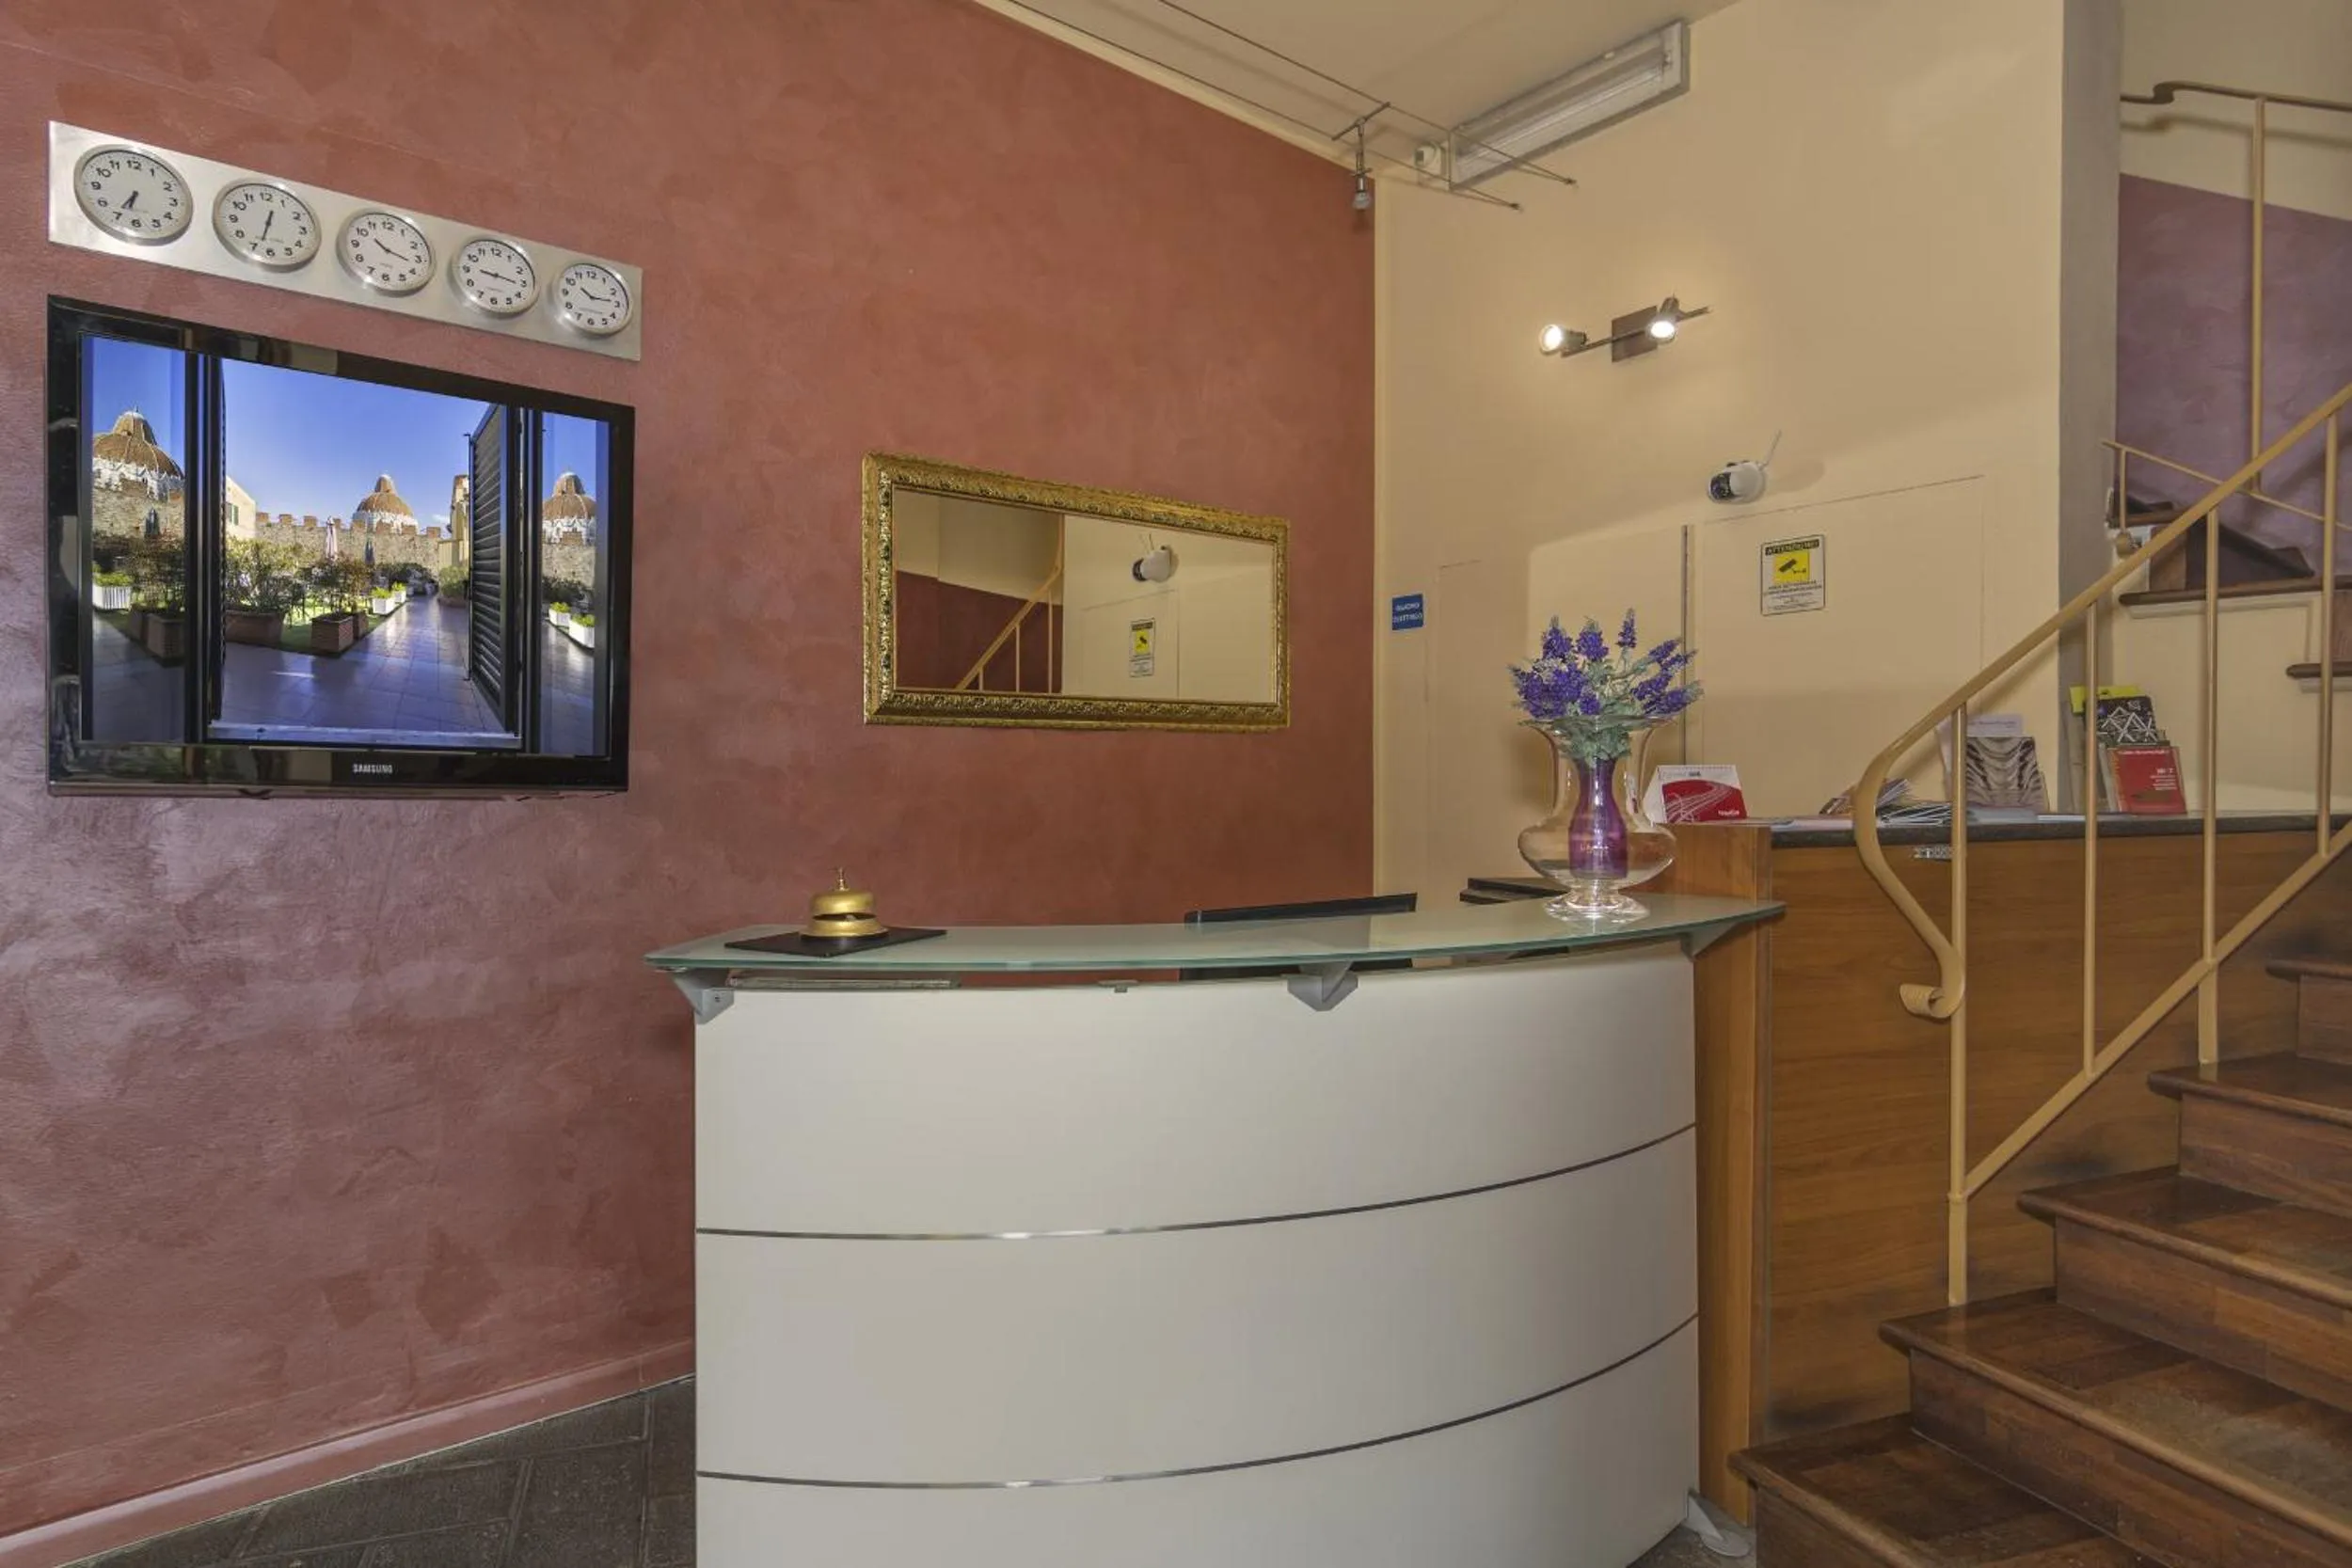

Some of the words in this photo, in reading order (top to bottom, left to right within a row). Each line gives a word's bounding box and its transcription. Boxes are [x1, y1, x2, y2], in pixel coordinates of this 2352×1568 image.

[109, 160, 120, 169] 11
[126, 160, 141, 170] 12
[96, 167, 112, 178] 10
[91, 182, 101, 190] 9
[163, 182, 172, 192] 2
[245, 193, 254, 202] 11
[260, 192, 273, 202] 12
[169, 198, 178, 206] 3
[232, 201, 246, 211] 10
[113, 211, 122, 220] 7
[164, 212, 173, 220] 4
[229, 214, 238, 223] 9
[293, 212, 301, 220] 2
[131, 218, 141, 228] 6
[151, 219, 161, 228] 5
[368, 221, 376, 230] 11
[382, 221, 394, 230] 12
[299, 226, 308, 235] 3
[357, 228, 369, 237] 10
[249, 242, 258, 251] 7
[294, 240, 303, 248] 4
[410, 241, 418, 249] 2
[266, 248, 276, 257] 6
[284, 247, 293, 256] 5
[490, 248, 501, 258] 12
[415, 255, 422, 263] 3
[468, 254, 479, 262] 10
[367, 266, 375, 275] 7
[516, 266, 524, 275] 2
[586, 271, 596, 279] 12
[520, 279, 527, 288] 3
[565, 277, 576, 286] 10
[477, 290, 485, 298] 7
[352, 763, 393, 773] SAMSUNG
